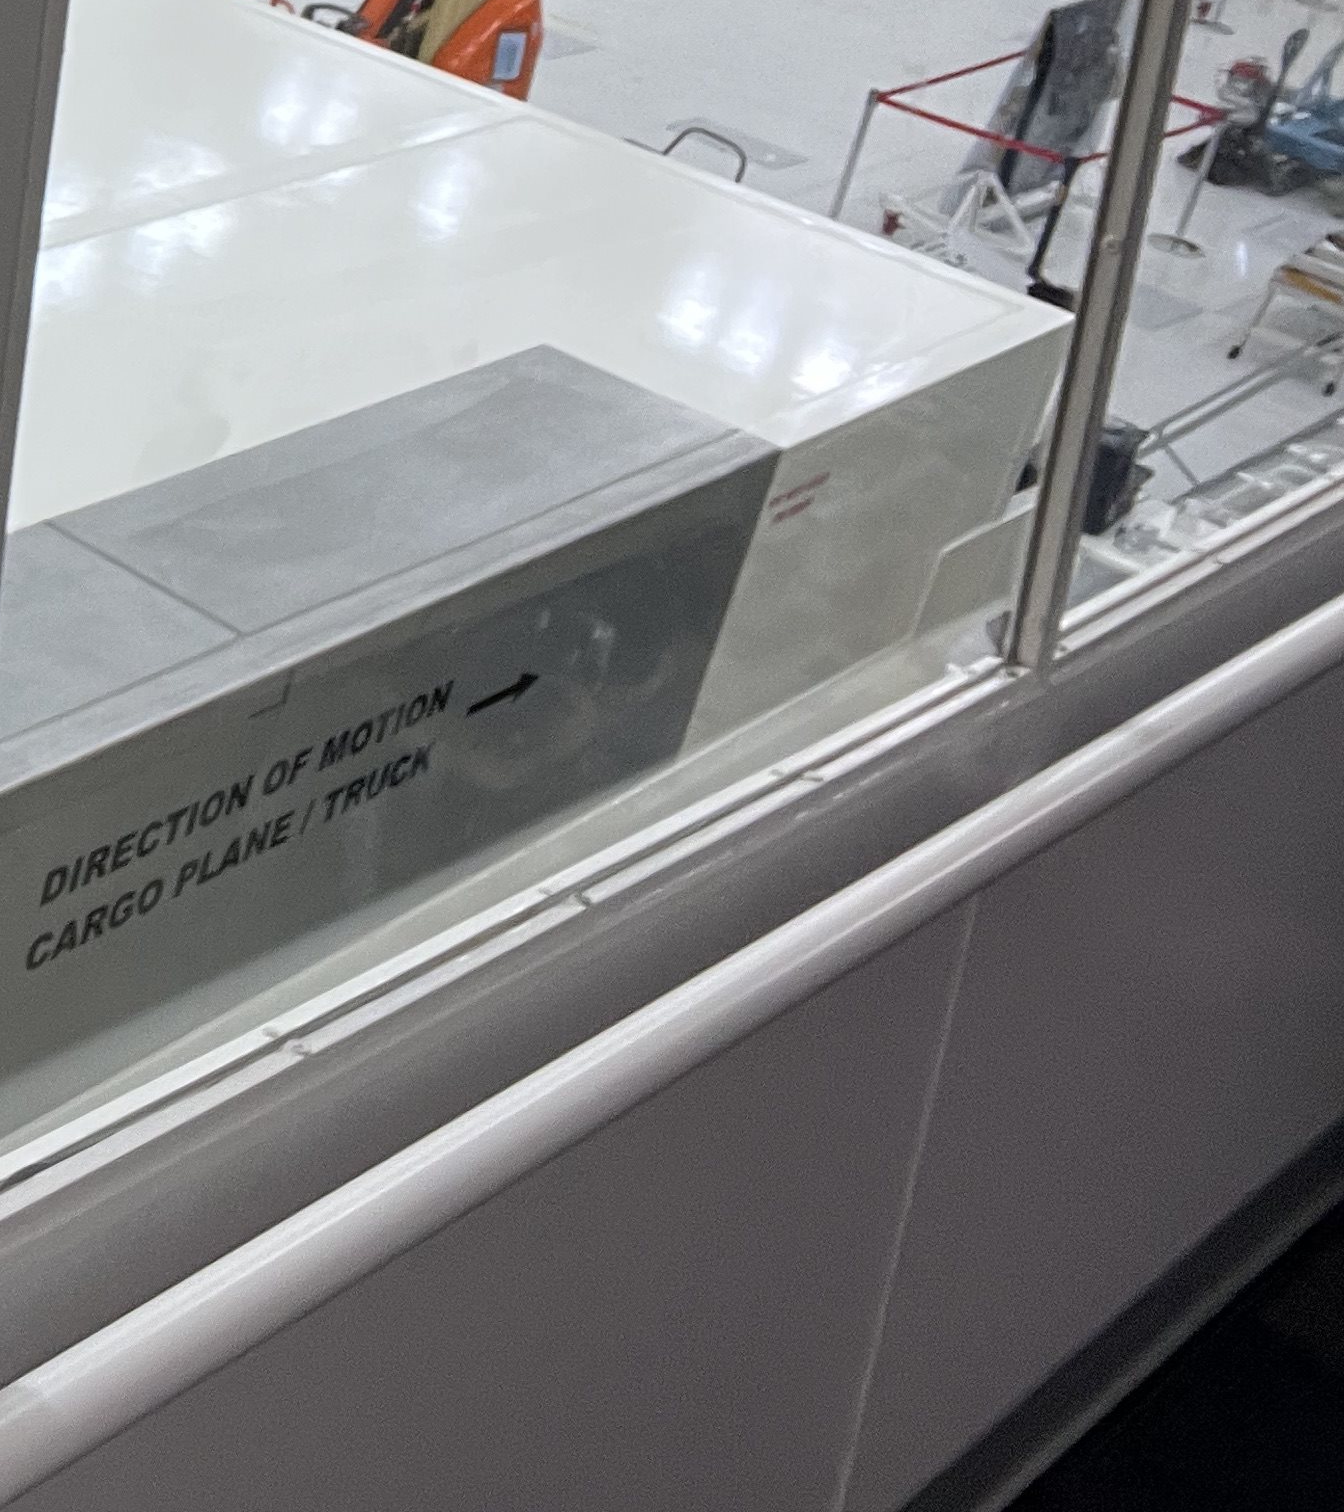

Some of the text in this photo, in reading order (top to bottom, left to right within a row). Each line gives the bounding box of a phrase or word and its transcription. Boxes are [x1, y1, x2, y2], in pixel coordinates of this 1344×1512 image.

[25, 740, 437, 971] CARGO PLANE / TRUCK
[40, 679, 455, 907] DIRECTION OF MOTION
